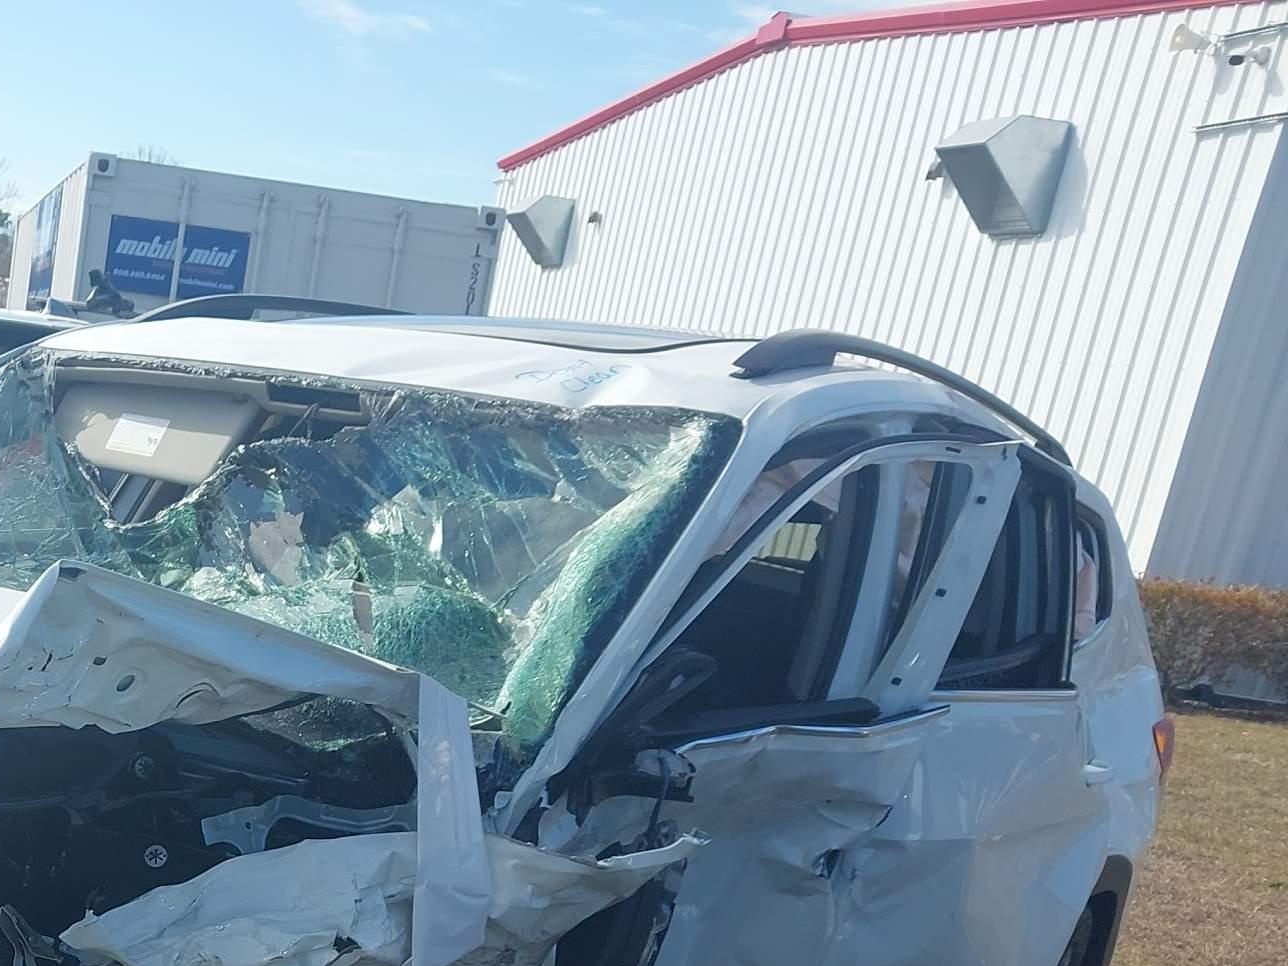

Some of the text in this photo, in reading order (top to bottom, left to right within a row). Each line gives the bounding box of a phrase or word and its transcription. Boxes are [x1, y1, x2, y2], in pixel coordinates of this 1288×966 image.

[115, 235, 238, 268] mobil mini
[560, 364, 633, 393] Clean
